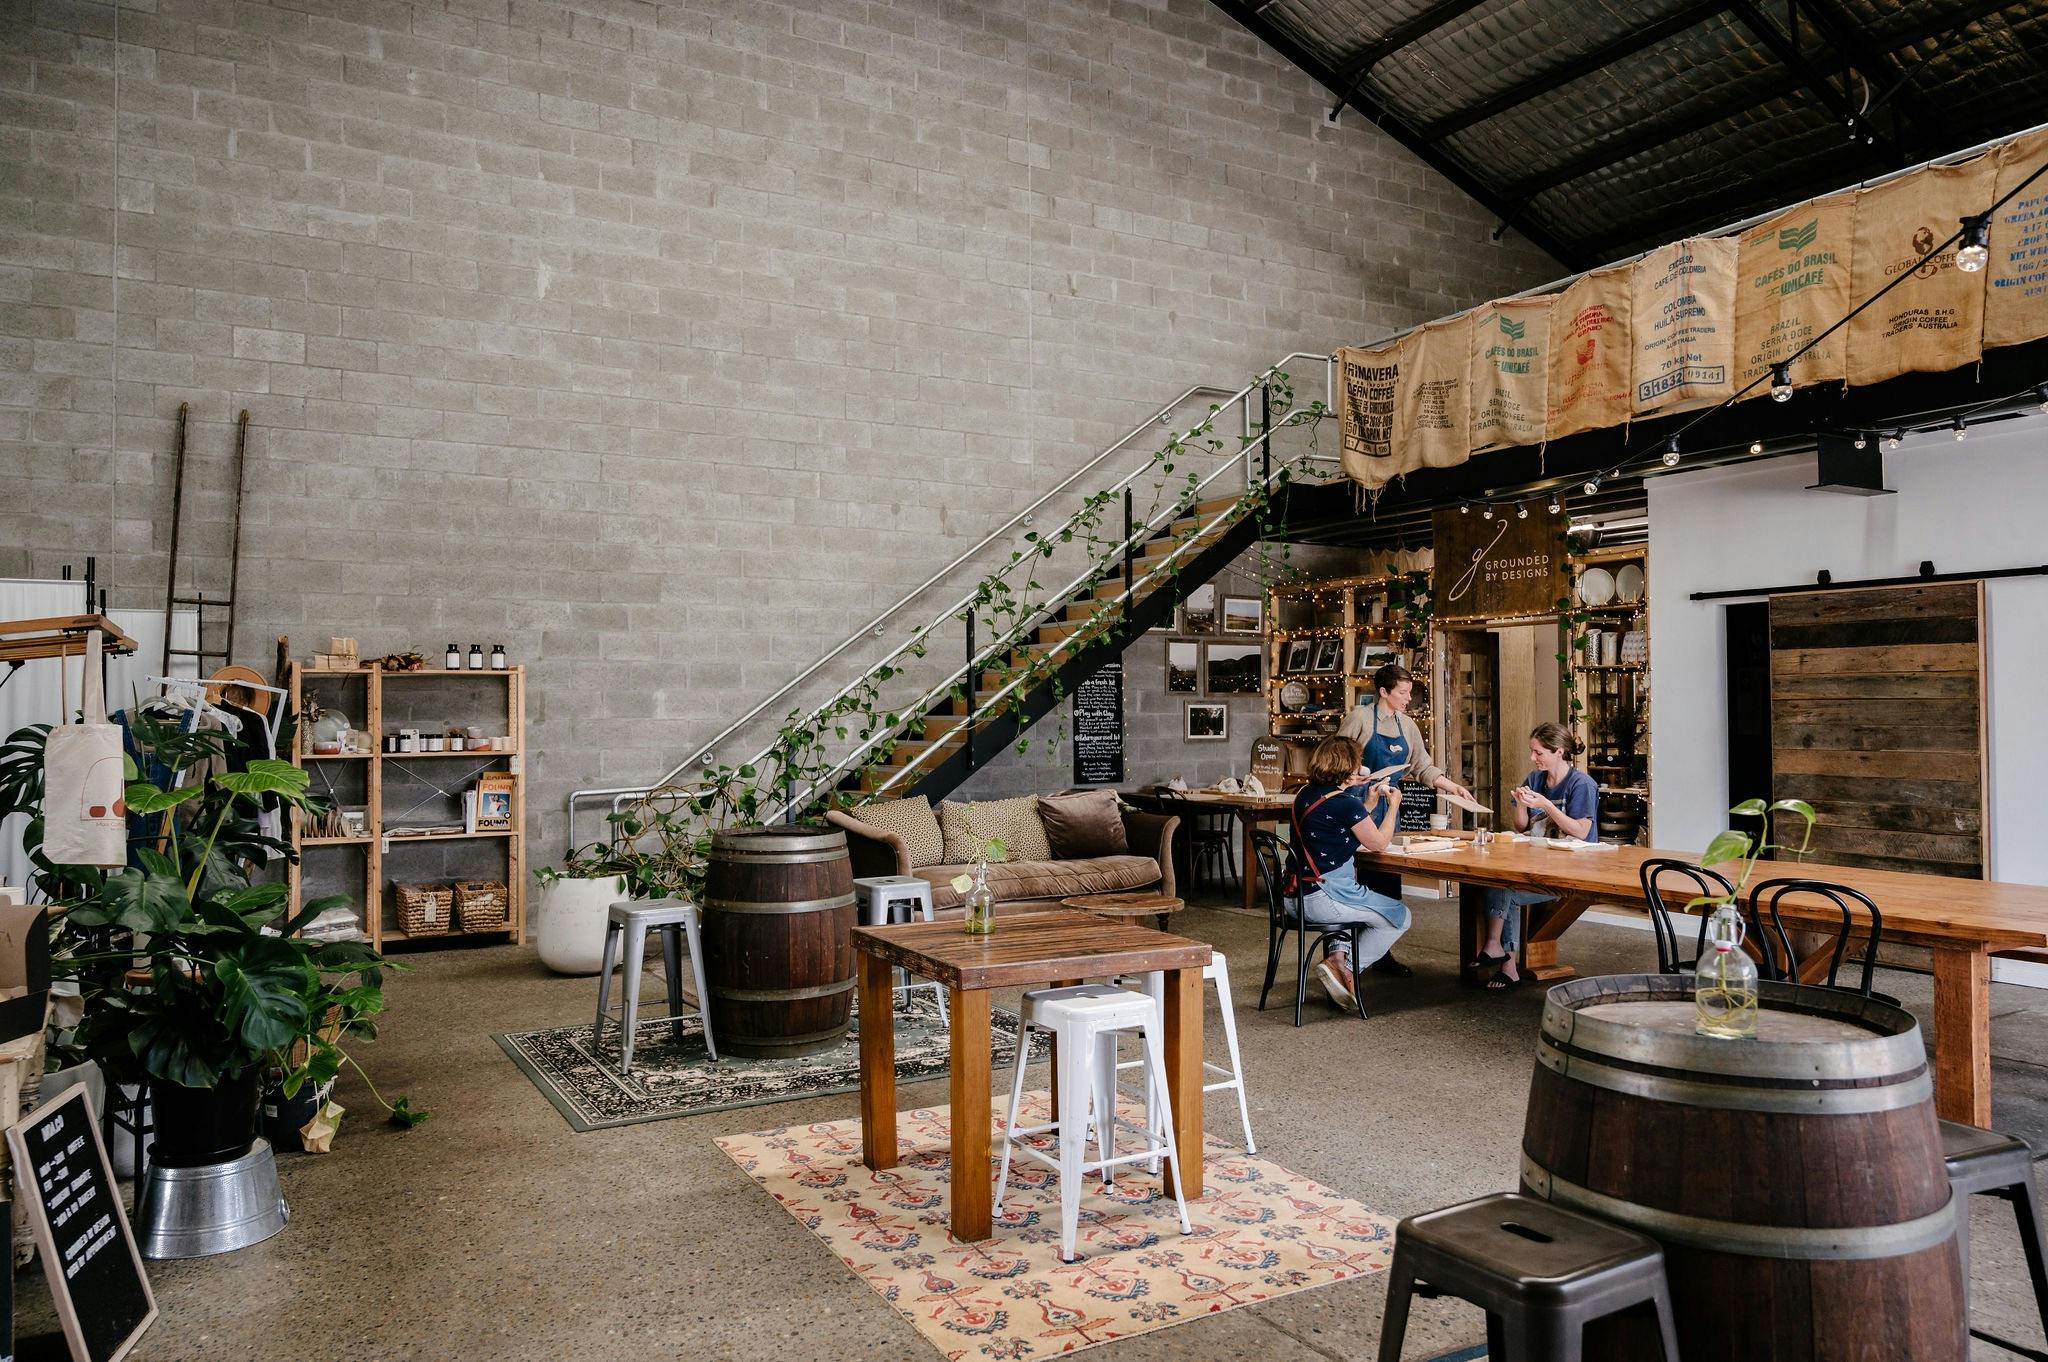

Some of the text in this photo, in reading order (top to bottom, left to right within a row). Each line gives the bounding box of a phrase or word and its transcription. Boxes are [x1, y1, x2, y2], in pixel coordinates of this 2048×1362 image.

[1668, 255, 1694, 273] EXCELSO
[1787, 260, 1801, 275] DO
[1803, 252, 1838, 268] BRASIL
[1927, 252, 1957, 265] COFFE
[1940, 262, 1957, 270] GROU
[1669, 270, 1678, 281] DE
[1678, 265, 1707, 277] COLOMBIA
[1663, 295, 1697, 315] COLOMBIA
[1653, 307, 1706, 331] HUILA SUPREMO
[1888, 308, 1929, 324] HONDURAS
[1892, 316, 1917, 330] ORIGIN
[1770, 316, 1801, 335] BRAZIL
[1881, 321, 1958, 338] TRADERS AUSTRALIA
[1644, 338, 1667, 351] ORIGIN
[1666, 328, 1690, 343] COFFEE
[1666, 336, 1697, 351] AUSTRALIA
[1760, 325, 1812, 351] SERRA DOCE
[1507, 348, 1515, 357] DO
[1516, 347, 1539, 358] BRASIL
[1750, 338, 1819, 365] ORIGIN COFF
[1787, 352, 1832, 367] STRALIA
[1661, 353, 1703, 371] 70 kg Net
[1642, 385, 1652, 397] 3
[1653, 371, 1684, 394] 1832
[1369, 385, 1394, 401] COFFEE
[1495, 388, 1511, 398] BZIL
[1345, 421, 1358, 436] 150
[1485, 554, 1549, 571] GROUNDED
[1485, 567, 1549, 582] BY DESIGNS
[1257, 744, 1280, 753] Studio
[1260, 753, 1277, 761] Open
[482, 783, 512, 791] FOUND
[478, 819, 509, 828] FOUND
